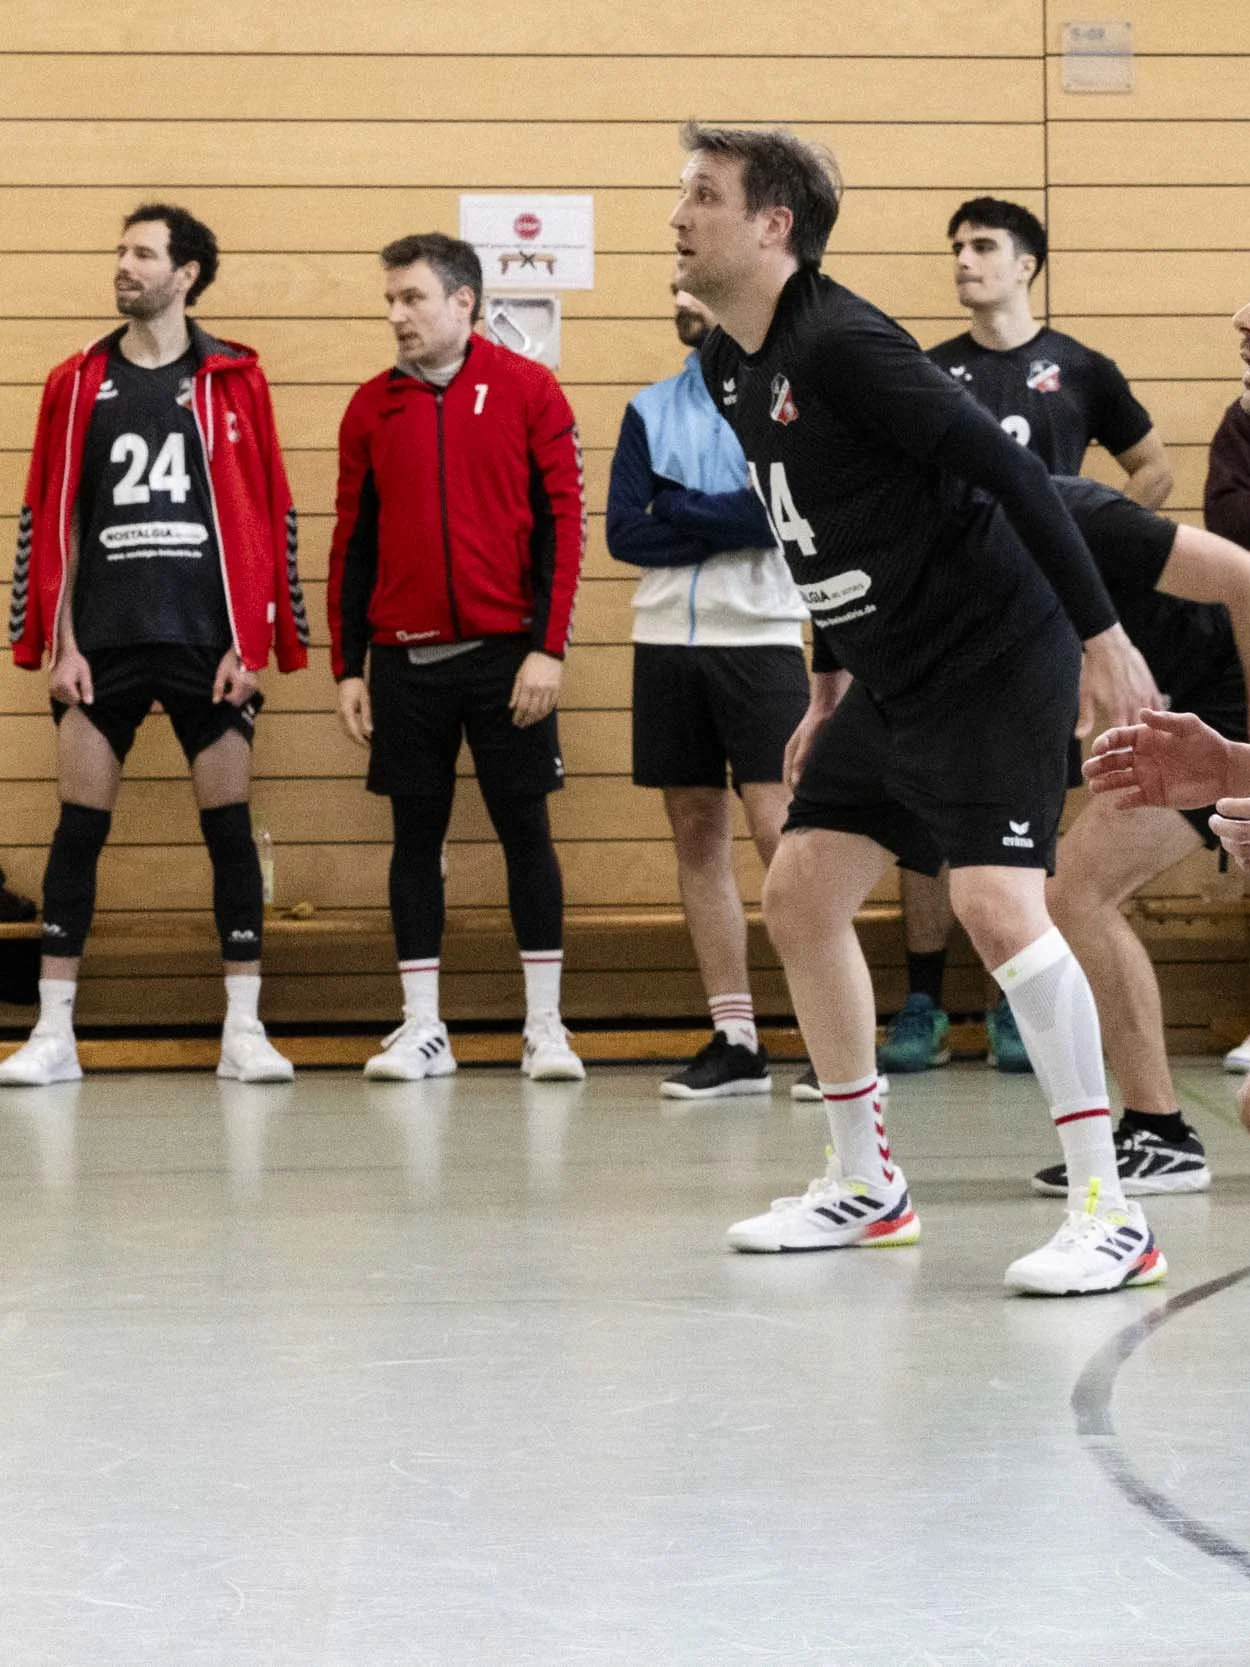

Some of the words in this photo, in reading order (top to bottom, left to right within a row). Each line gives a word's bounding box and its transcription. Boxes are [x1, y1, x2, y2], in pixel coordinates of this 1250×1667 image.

[473, 383, 489, 415] 1
[109, 432, 191, 506] 24
[106, 528, 172, 541] NOSTALGIA
